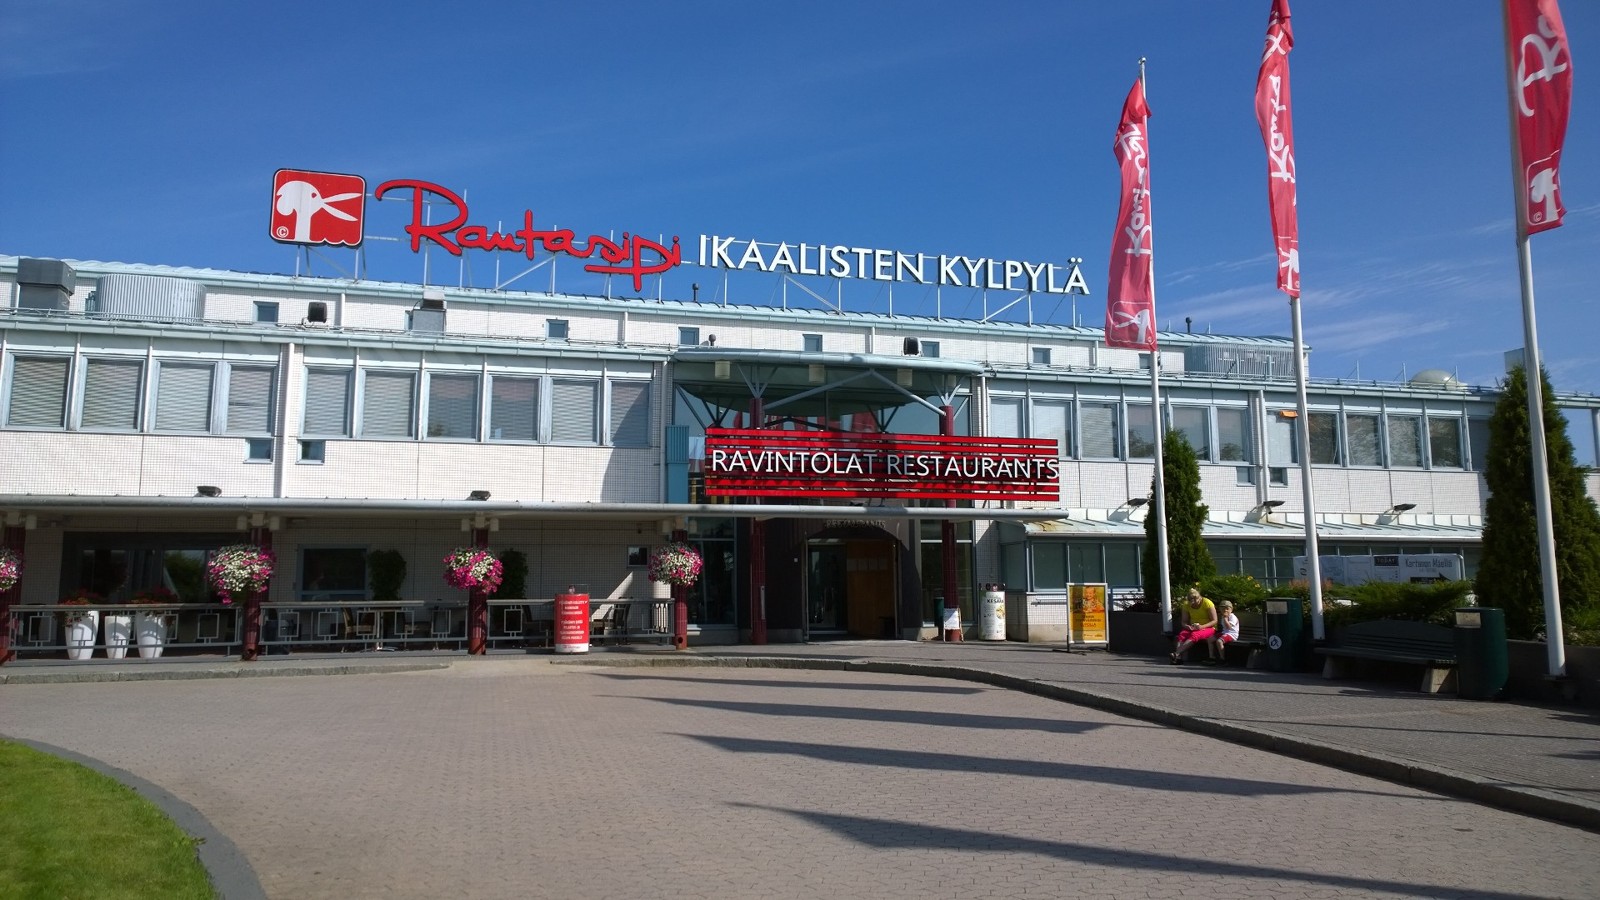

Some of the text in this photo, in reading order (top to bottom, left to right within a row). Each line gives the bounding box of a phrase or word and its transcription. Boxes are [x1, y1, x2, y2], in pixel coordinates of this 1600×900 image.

[375, 178, 681, 292] Rantasipi
[699, 234, 1091, 296] IKAALISTEN KYLPYLÄ
[711, 449, 1060, 480] RAVINTOLAT RESTAURANTS
